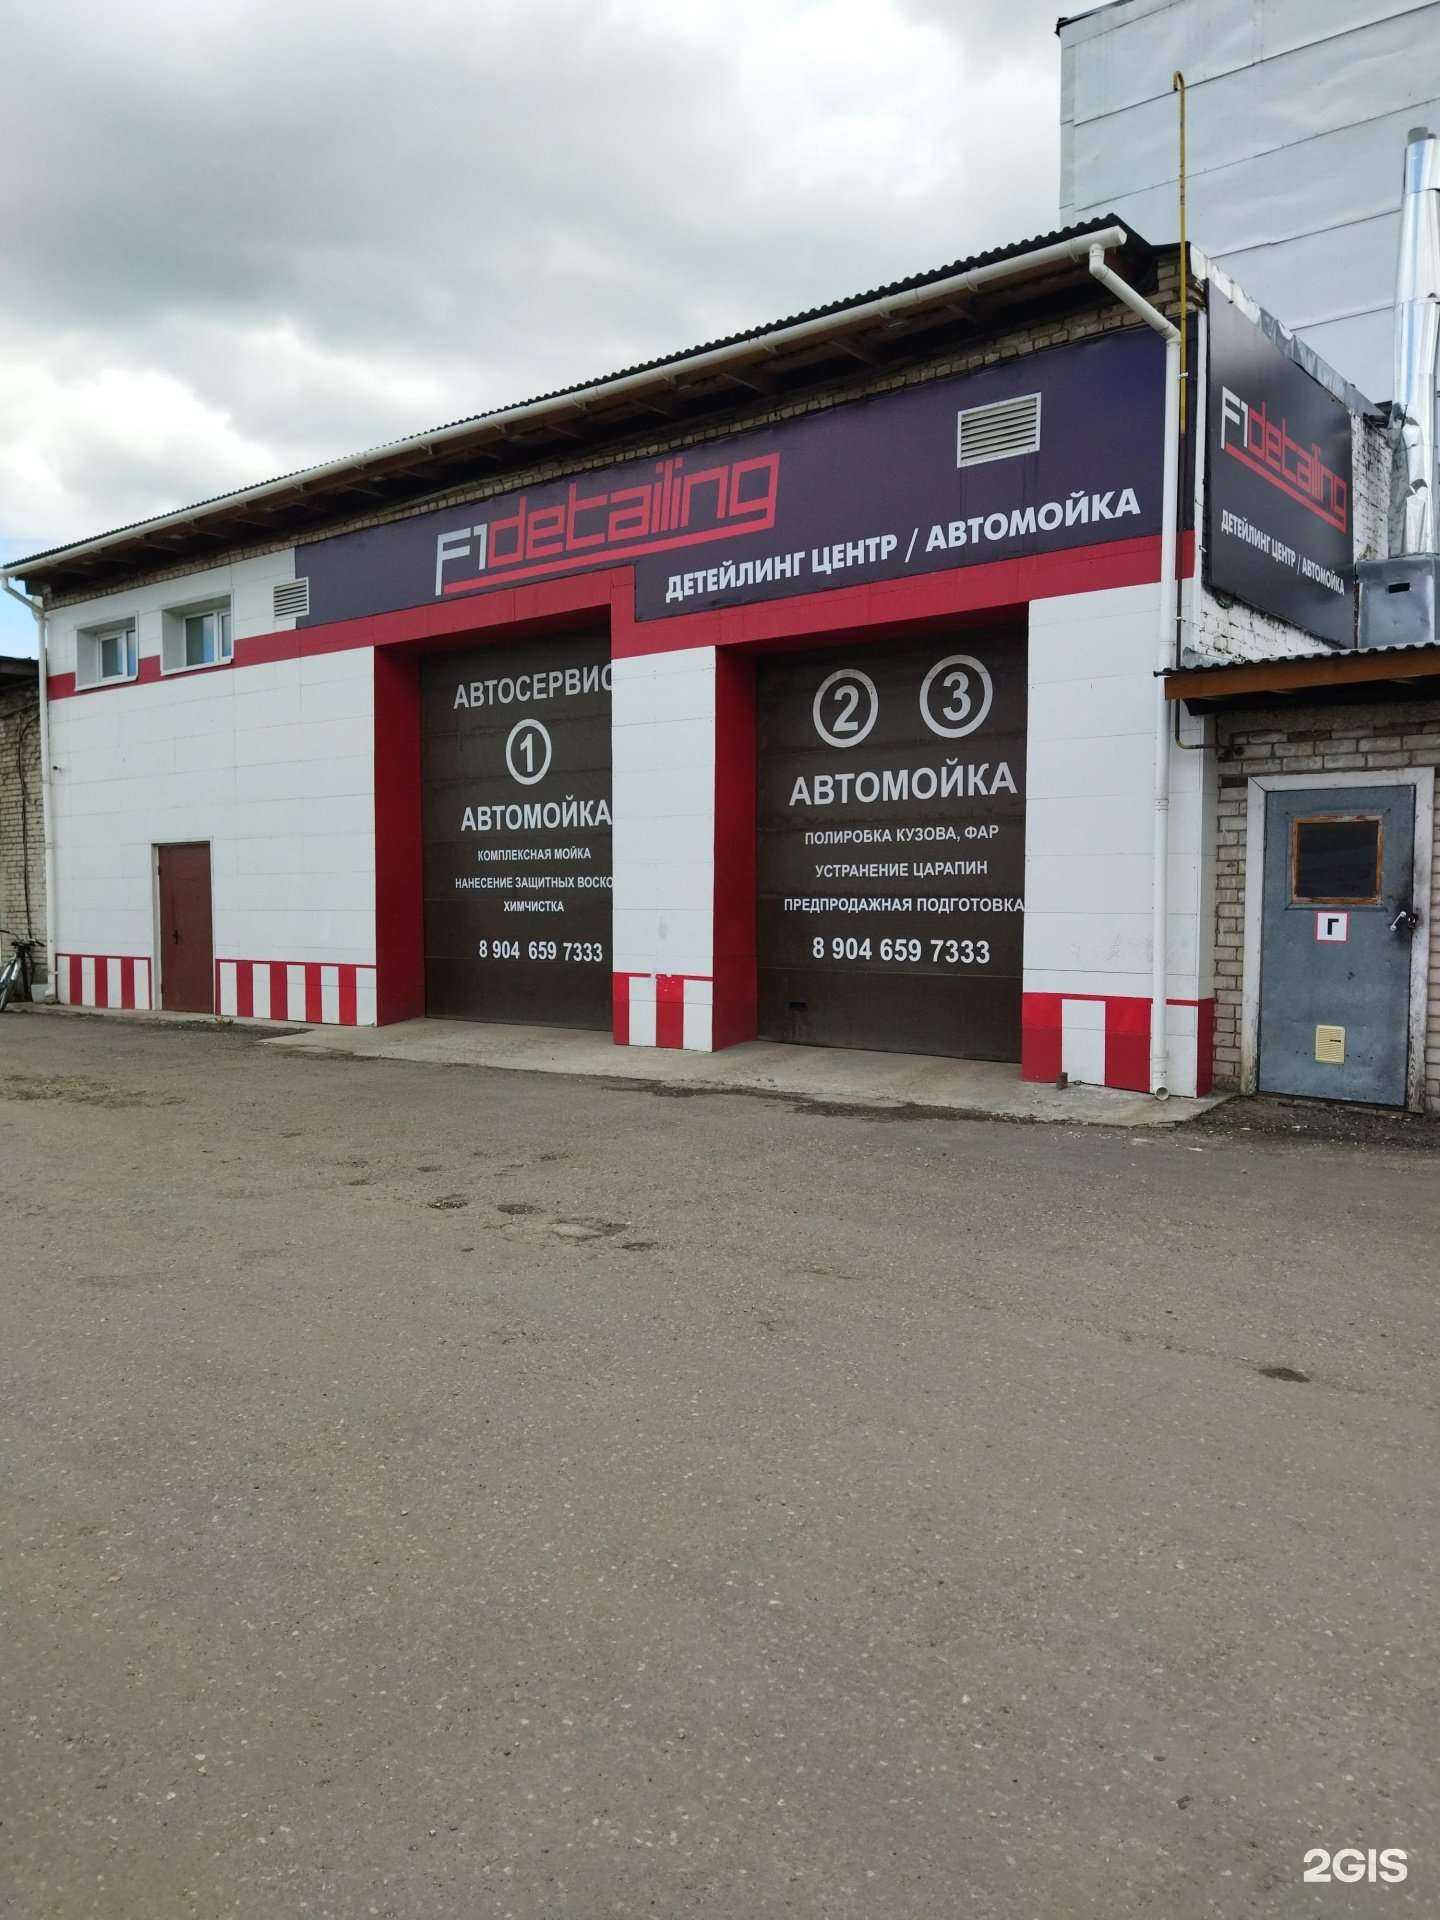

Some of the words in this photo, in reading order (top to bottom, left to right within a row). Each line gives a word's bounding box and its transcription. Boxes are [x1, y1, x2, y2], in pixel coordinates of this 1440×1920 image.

[665, 552, 806, 603] ДЕТЕЙЛИНГ
[810, 533, 898, 576] ЦЕНТР
[904, 527, 919, 563] /
[925, 487, 1141, 552] АВТОМОЙКА
[1221, 509, 1271, 553] ДЕТЕЙЛИНГ
[1271, 537, 1296, 568] ЦЕНТР
[1301, 556, 1345, 596] АВТОМОЙКА
[833, 684, 859, 732] 2
[943, 671, 971, 721] 3
[520, 733, 534, 773] 1
[789, 757, 1018, 806] АВТОМОЙКА
[460, 794, 613, 832] АВТОМОЙКА
[805, 829, 893, 845] ПОЛИРОВКА
[896, 826, 961, 843] КУЗОВА,
[964, 824, 1000, 840] ФАР
[477, 848, 552, 862] КОМПЛЕКСНАЯ
[554, 846, 591, 860] МОЙКА
[815, 862, 909, 878] УСТРАНЕНИЕ
[913, 861, 988, 879] ЦАРАПИН
[455, 877, 513, 889] НАНЕСЕНИЕ
[515, 876, 575, 890] ЗАЩИТНЫХ
[503, 900, 565, 912] ХИМЧИСТКА
[784, 898, 912, 914] ПРЕДПРОДАЖНАЯ
[916, 898, 1025, 914] ПОДГОТОВКА
[479, 940, 488, 958] 8
[492, 941, 520, 959] 904
[528, 941, 557, 960] 659
[563, 942, 603, 962] 7333
[812, 937, 825, 959] 8
[832, 937, 872, 960] 904
[880, 938, 922, 962] 659
[930, 939, 990, 964] 7333
